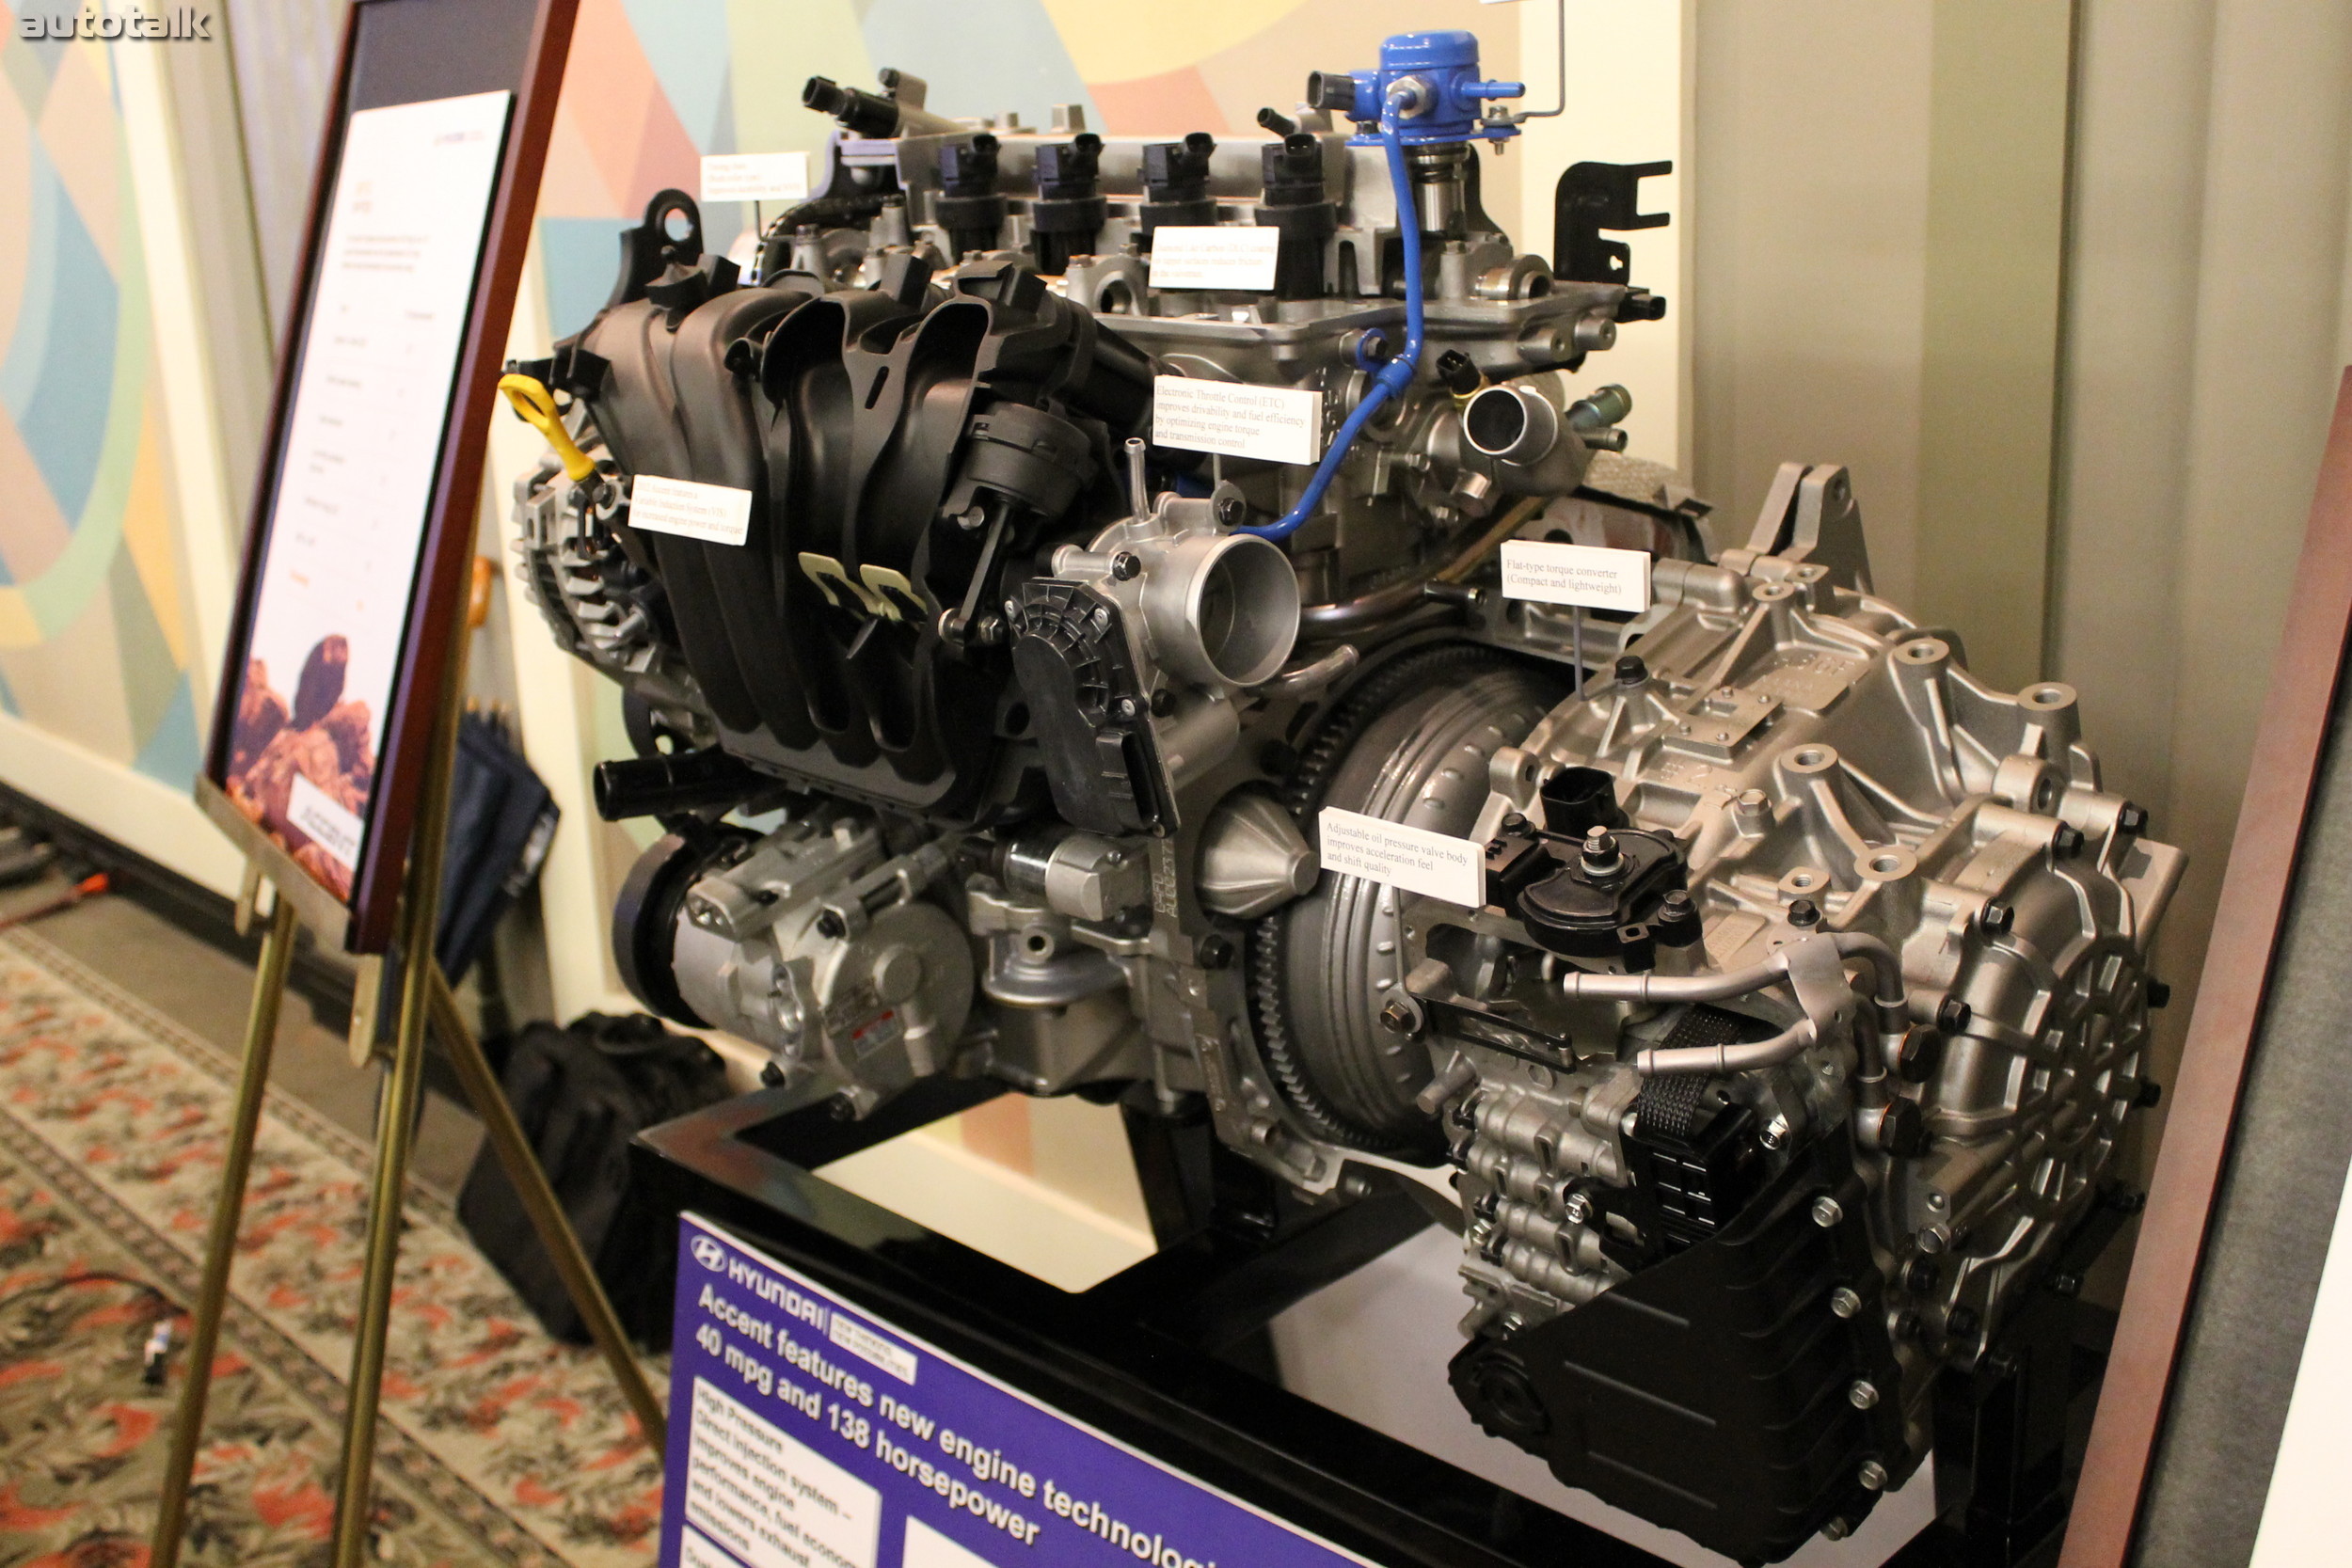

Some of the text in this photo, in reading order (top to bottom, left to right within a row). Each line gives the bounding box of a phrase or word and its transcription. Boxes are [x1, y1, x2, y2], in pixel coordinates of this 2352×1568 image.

[1156, 385, 1285, 410] Electronic Throttle Control (ETC)
[1156, 403, 1305, 428] improves drivability and fuel efficiency
[1155, 414, 1261, 437] by optimizing engine torque
[1155, 429, 1246, 450] and transmission control
[1506, 559, 1618, 579] Flat-type torque converter
[1506, 573, 1622, 595] (Compact and lightweight)
[1327, 821, 1469, 867] Adjustable oil pressure valve body
[1327, 836, 1435, 871] improves acceleration feel
[1327, 852, 1392, 878] and shift quality
[727, 1256, 823, 1331] HYUNDAI
[698, 1283, 774, 1350] Accent
[777, 1328, 874, 1407] features
[879, 1394, 935, 1441] new
[939, 1429, 1037, 1499] engine
[695, 1323, 1041, 1545] 40 mpg and 138 horsepower
[697, 1387, 784, 1453] High Pressure
[695, 1434, 795, 1511] improves engine
[696, 1411, 730, 1442] Direct
[733, 1432, 787, 1481] injection
[790, 1474, 839, 1515] system
[691, 1501, 750, 1551] emissions
[692, 1480, 810, 1568] and lowers exhaust
[774, 1511, 800, 1537] fuel
